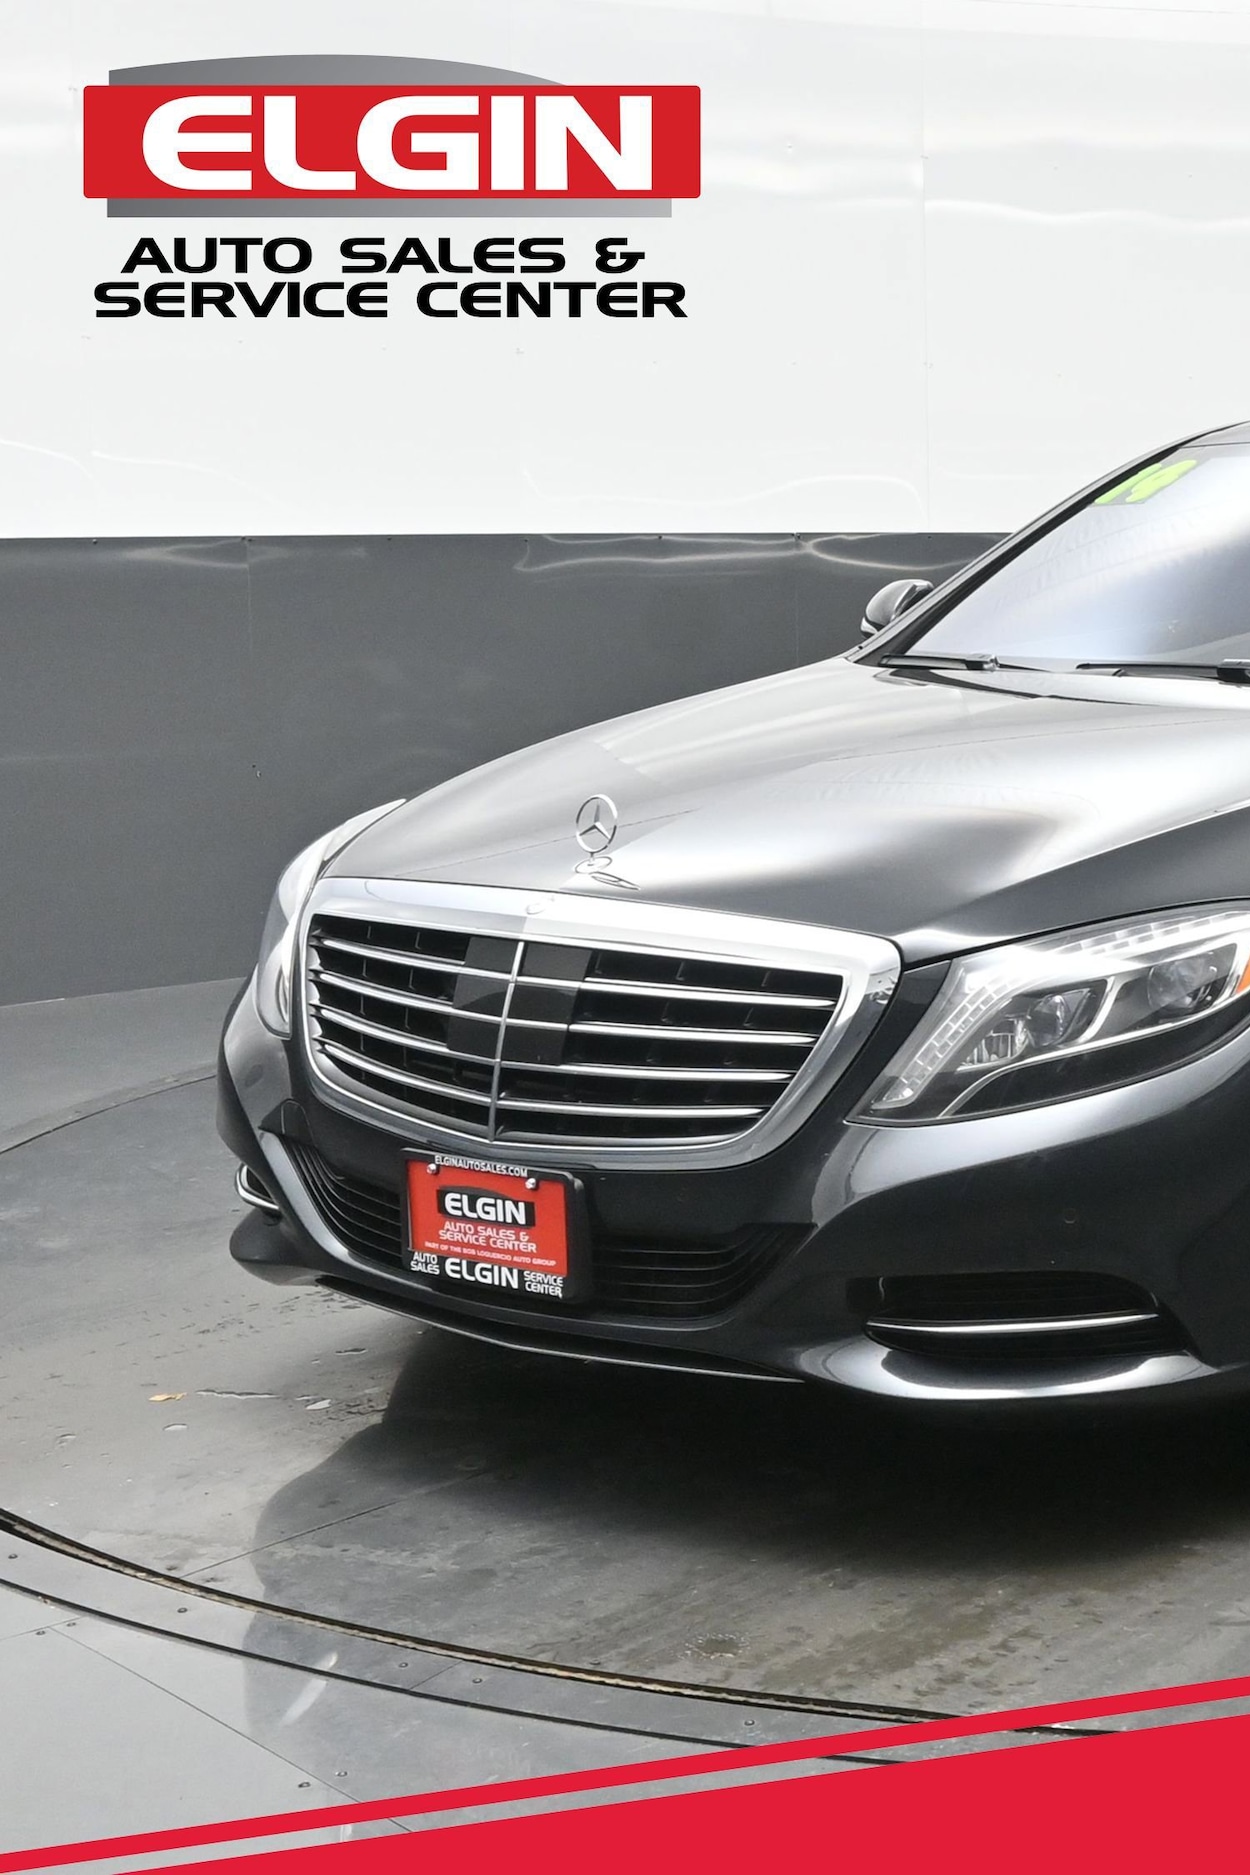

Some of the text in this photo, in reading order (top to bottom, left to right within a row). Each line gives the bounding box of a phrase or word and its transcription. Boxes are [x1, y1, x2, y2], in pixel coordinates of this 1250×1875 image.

[435, 1155, 528, 1177] ELGINAUTOSALES.COM
[444, 1192, 526, 1225] ELGIN
[444, 1221, 529, 1242] AUTO SALES &
[439, 1230, 537, 1253] SERVICE CENTER
[412, 1251, 438, 1265] AUTO
[513, 1255, 531, 1264] AUTO
[532, 1258, 556, 1266] GROUP
[410, 1261, 440, 1275] SALES
[445, 1258, 518, 1289] ELGIN
[523, 1270, 564, 1287] SERVICE
[525, 1282, 563, 1297] CENTER
